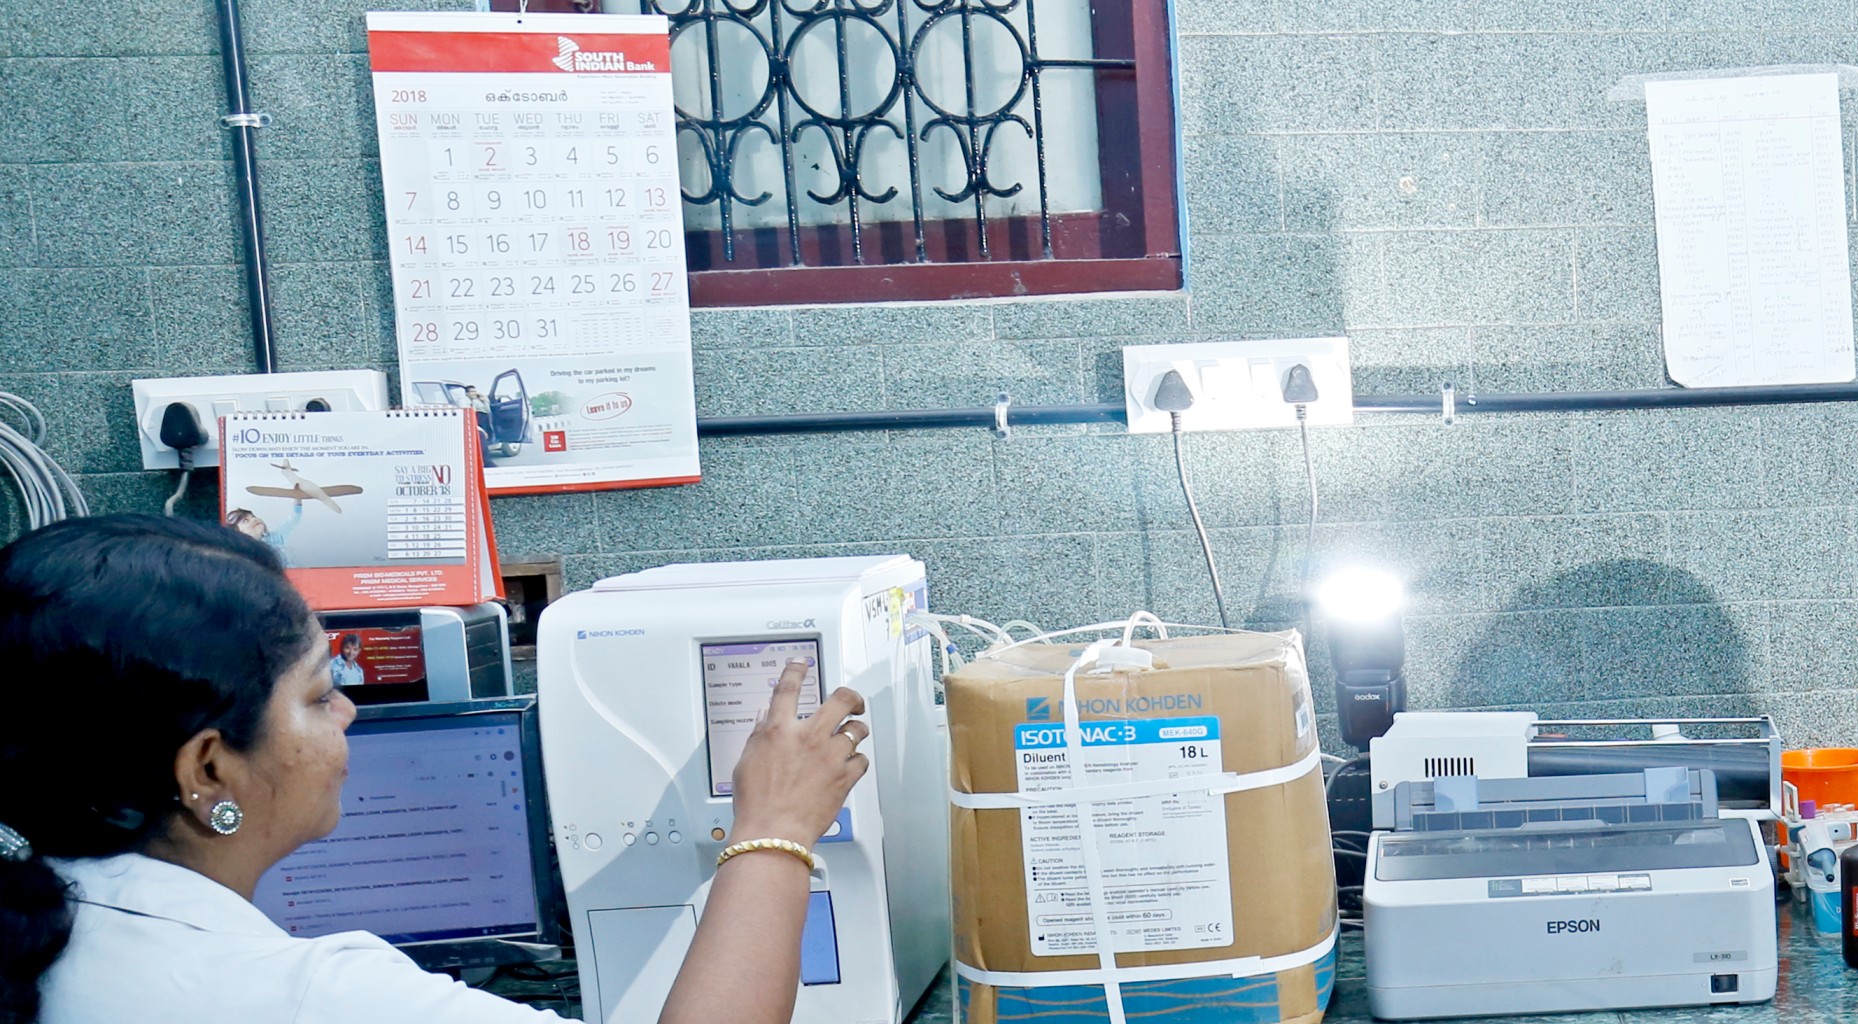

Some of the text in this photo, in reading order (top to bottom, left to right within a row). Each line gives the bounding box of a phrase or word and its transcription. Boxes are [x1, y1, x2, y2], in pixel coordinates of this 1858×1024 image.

[575, 52, 624, 61] SOUTH
[575, 61, 655, 71] INDIAN Bank
[391, 90, 427, 103] 2018
[390, 112, 661, 125] SUN MON TUE WED THU FRI SAT
[444, 145, 659, 167] 1 2 3 4 5 6
[405, 188, 666, 211] 7 8 9 10 11 12 13
[406, 230, 672, 255] 14 15 16 17 18 19 20
[412, 272, 673, 298] 21 22 23 24 25 26 27
[413, 322, 438, 342] 28
[453, 321, 479, 340] 29
[494, 320, 520, 339] 30
[537, 319, 558, 337] 31
[586, 400, 629, 415] Leave it to us
[232, 428, 261, 444] #10
[263, 433, 292, 444] ENJOY
[293, 434, 321, 443] LITTLE
[394, 466, 408, 474] SAY
[411, 466, 416, 474] A
[418, 465, 432, 474] BIG
[432, 465, 451, 485] NO
[396, 486, 437, 496] OCTOBER
[589, 628, 645, 638] NIHON KOHDEN
[707, 663, 716, 671] ID
[1058, 694, 1202, 715] HON KOHDEN
[1162, 727, 1205, 737] MEK-640G
[1023, 746, 1208, 764] Diluent 18 L
[1547, 919, 1600, 934] EPSON
